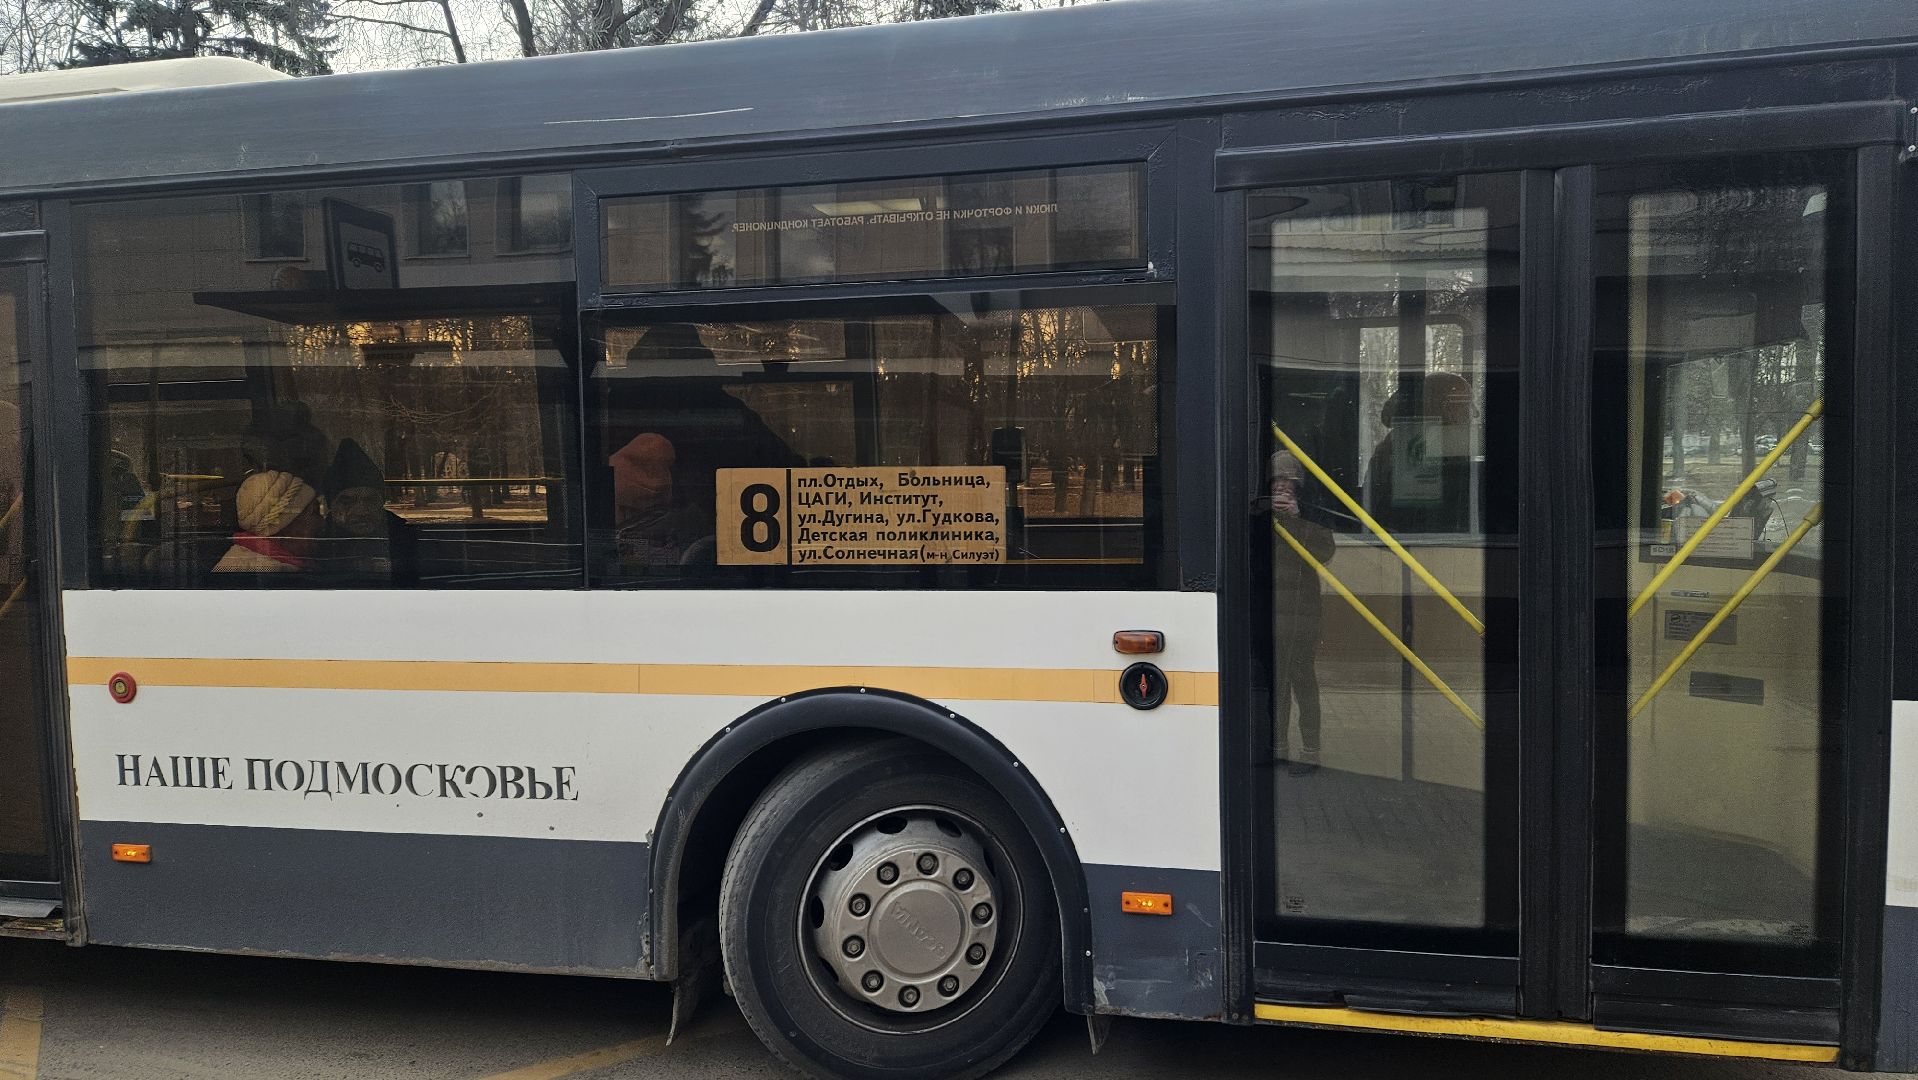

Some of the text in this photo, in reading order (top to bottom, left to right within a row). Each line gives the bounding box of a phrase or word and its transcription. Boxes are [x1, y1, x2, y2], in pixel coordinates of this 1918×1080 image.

[898, 473, 991, 487] Больница,
[798, 491, 943, 508] ЦАГИ, Институт,
[740, 483, 781, 552] 8
[797, 528, 1000, 544] Детская поликлиника,
[115, 754, 579, 802] НАШЕ ПОДМОСКОВЬЕ
